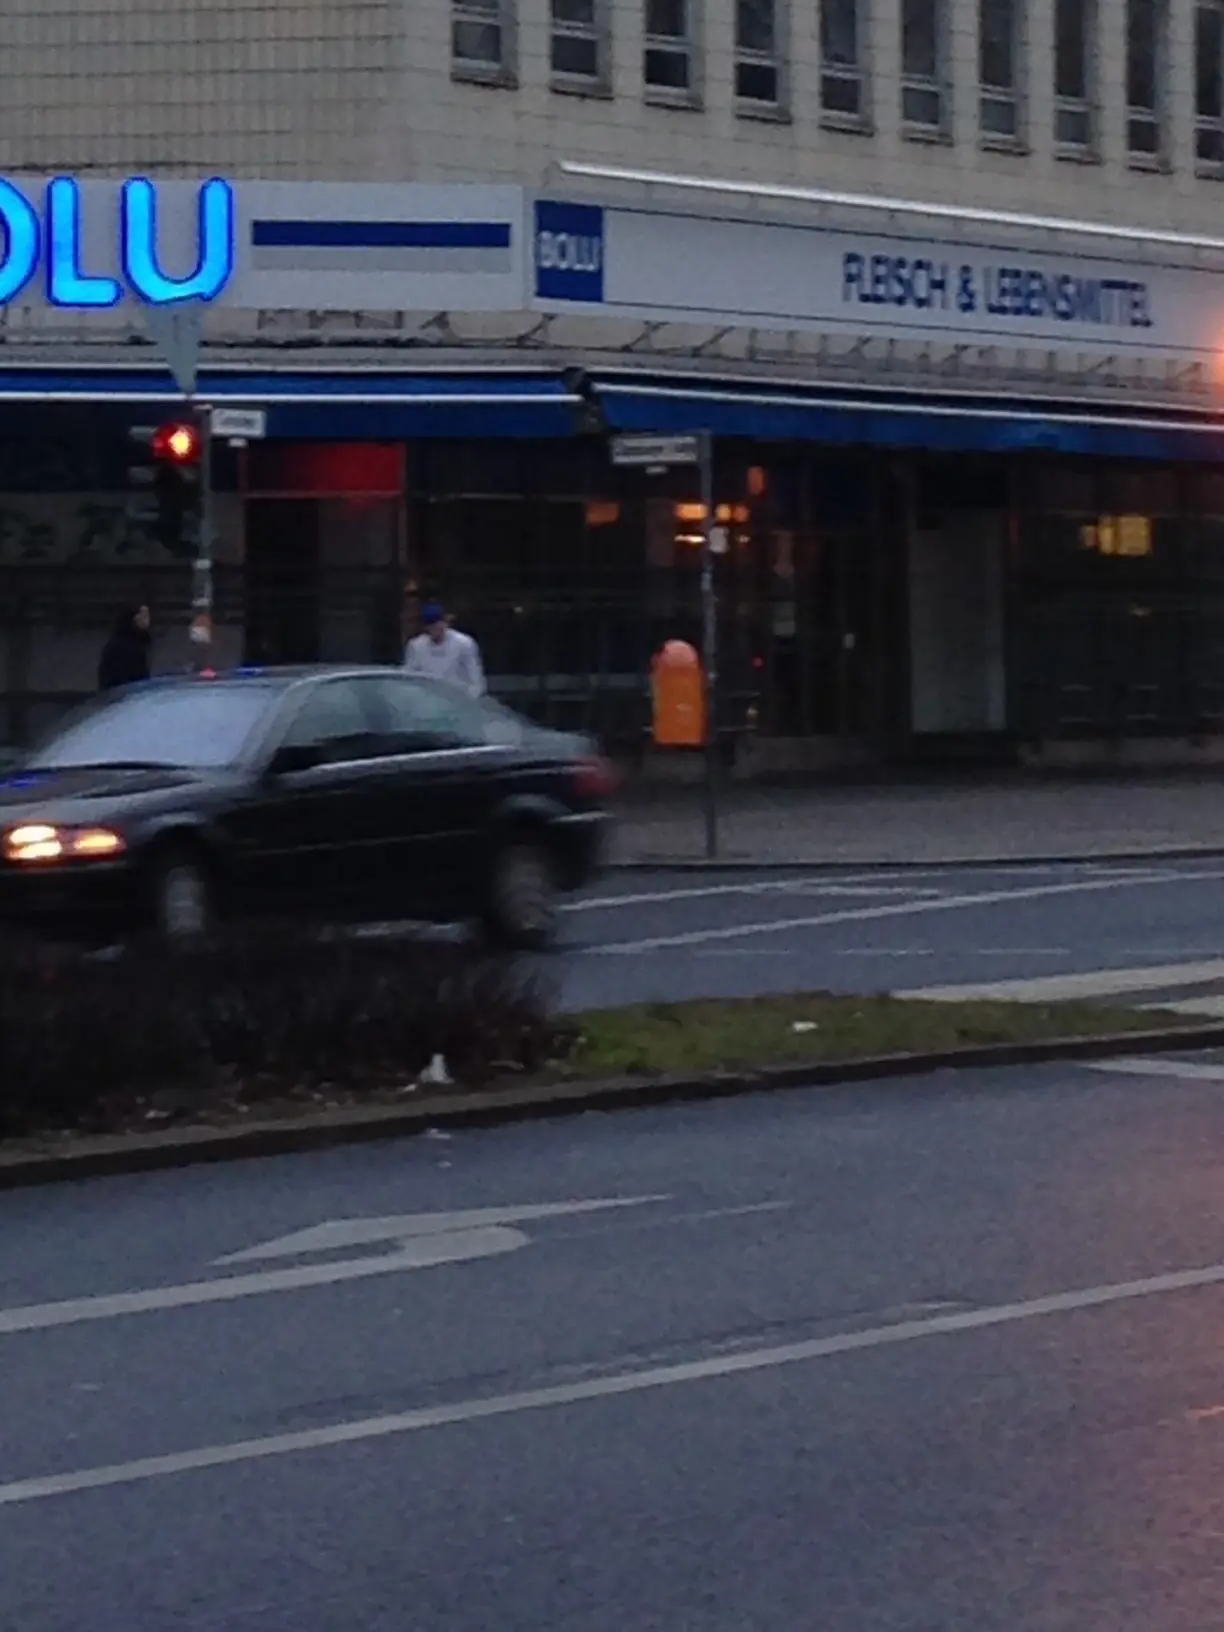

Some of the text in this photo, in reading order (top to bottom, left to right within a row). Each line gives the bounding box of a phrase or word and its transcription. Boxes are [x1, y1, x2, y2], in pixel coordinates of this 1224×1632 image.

[537, 230, 600, 272] BOLU
[842, 252, 1153, 328] FLEISCH & LEBENSMITTEL
